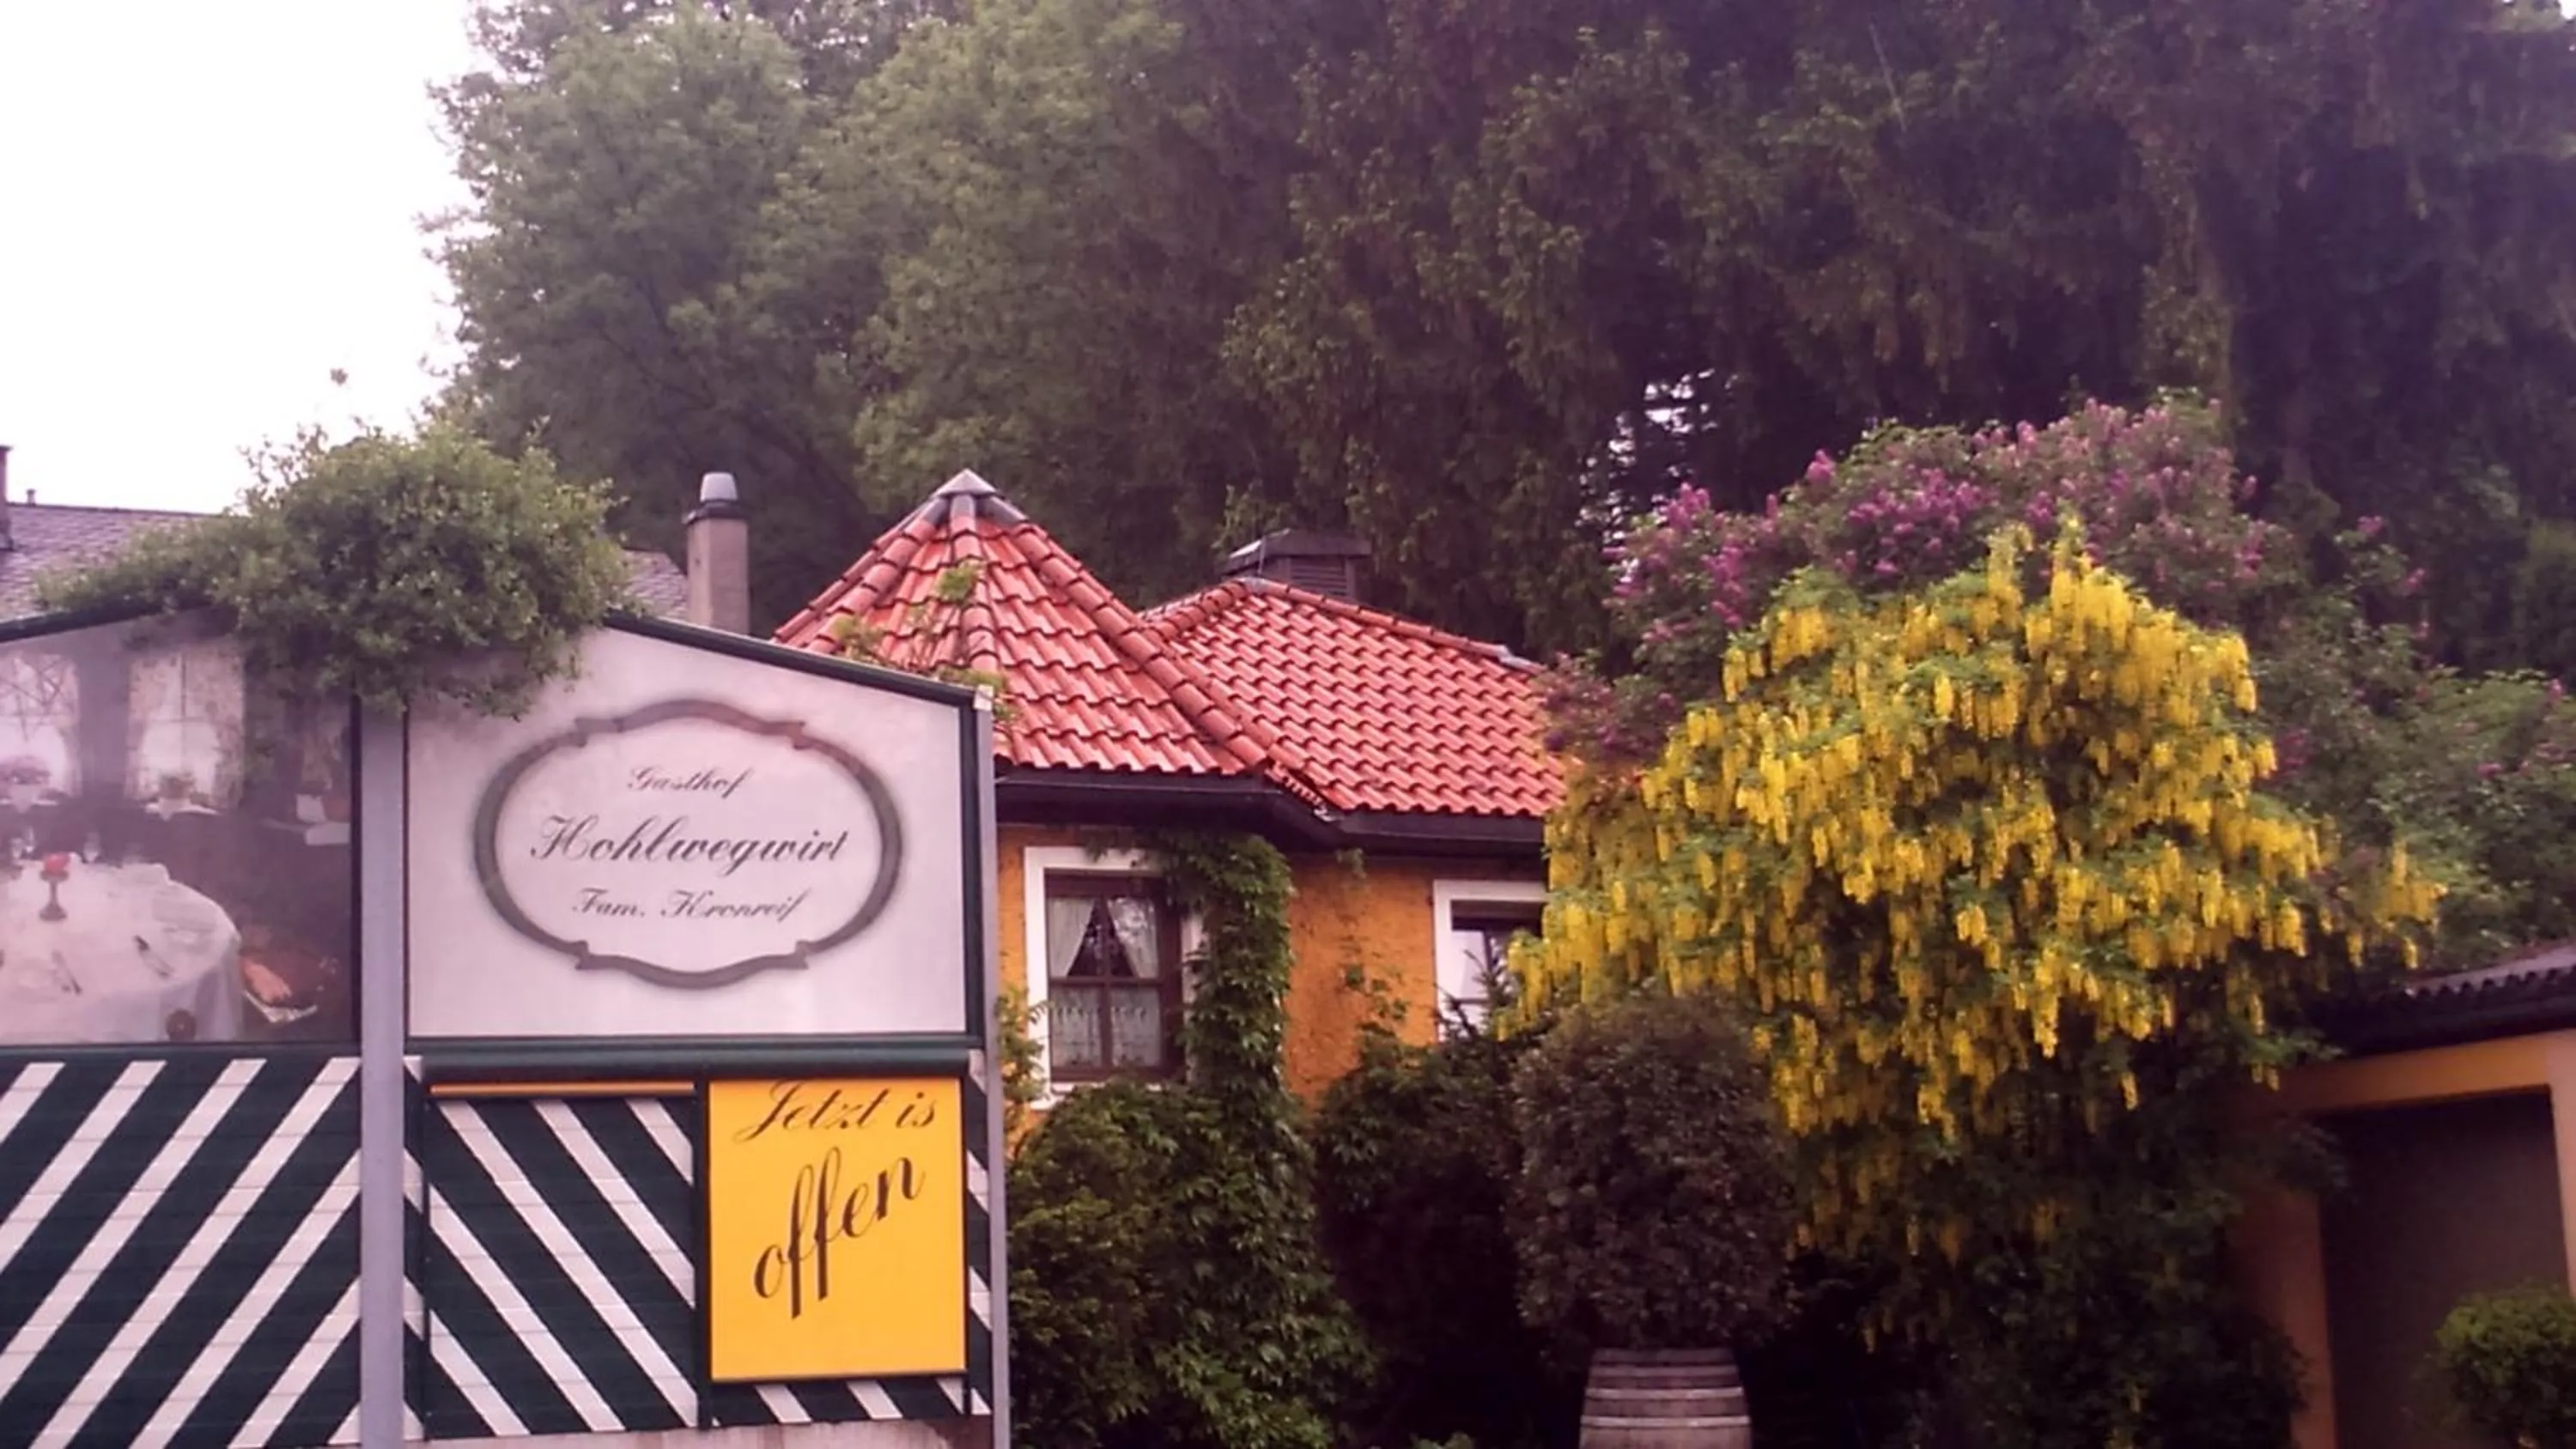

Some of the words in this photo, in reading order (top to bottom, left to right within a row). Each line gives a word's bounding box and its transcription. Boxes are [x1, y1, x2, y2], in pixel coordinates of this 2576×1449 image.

[628, 767, 755, 799] Gasthof
[530, 814, 849, 876] Hohlwegwirt
[572, 886, 646, 918] Fam.
[660, 886, 811, 922] Kronreif
[732, 1078, 890, 1144] Jetzt
[896, 1091, 938, 1130] is
[753, 1145, 927, 1320] offen
